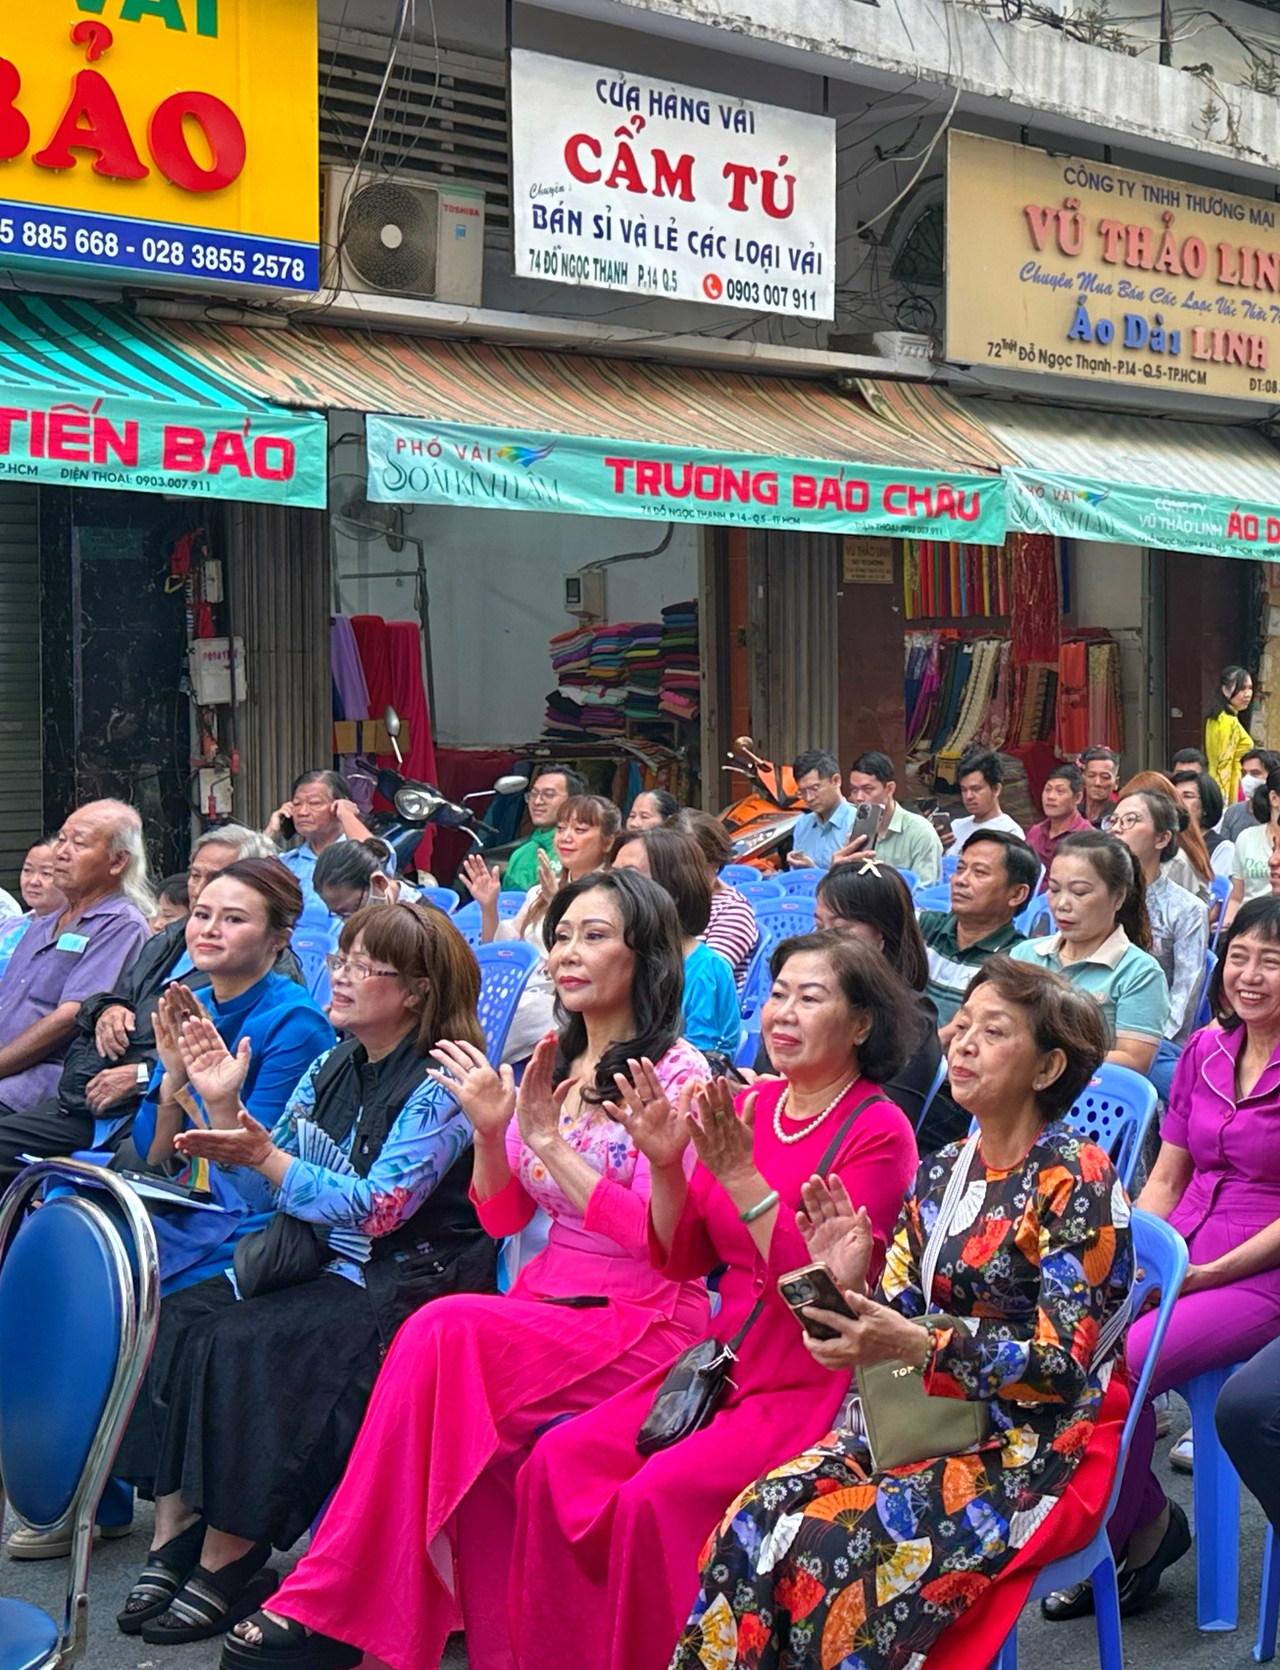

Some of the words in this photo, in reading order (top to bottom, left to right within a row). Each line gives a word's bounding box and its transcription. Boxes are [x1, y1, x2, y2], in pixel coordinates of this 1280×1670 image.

[596, 72, 640, 112] CỬA
[649, 87, 710, 126] HÀNG
[719, 99, 755, 135] VẢI
[564, 115, 696, 203] CẨM
[723, 155, 796, 219] TÚ
[1063, 165, 1114, 195] CÔNG
[1117, 179, 1136, 200] TY
[1142, 184, 1180, 210] TNHH
[1186, 194, 1245, 222] THƯƠNG
[443, 204, 480, 217] TOSHIBA
[532, 200, 582, 236] BÁN
[593, 205, 611, 240] SỈ
[620, 213, 646, 248] VÀ
[654, 217, 679, 252] LẺ
[687, 227, 727, 259] CÁC
[735, 238, 780, 273] LOẠI
[789, 242, 822, 275] VẢI
[1024, 197, 1085, 257] VŨ
[1099, 210, 1207, 280] THẢO
[22, 222, 67, 250] 885
[75, 229, 119, 256] 668
[142, 238, 184, 265] 028
[191, 245, 245, 273] 3855
[252, 253, 305, 282] 2578
[529, 248, 541, 273] 74
[727, 278, 759, 304] 0903
[764, 284, 788, 308] 007
[793, 289, 816, 312] 911
[1019, 261, 1074, 292] Chuyên
[1077, 272, 1113, 295] Mua
[1118, 279, 1145, 302] Bán
[1150, 287, 1177, 307] Các
[1038, 349, 1073, 371] Ngọc
[1123, 312, 1181, 356] Dài
[1191, 325, 1269, 371] LINH
[163, 417, 295, 481] BẢO
[396, 437, 442, 458] PHỐ
[61, 467, 89, 482] ĐIỆN
[136, 475, 211, 491] 0903.007.911
[604, 457, 778, 506] TRƯƠNG
[792, 467, 869, 513] BẢO
[882, 482, 980, 522] CHÂU
[1226, 504, 1259, 542] ÁO
